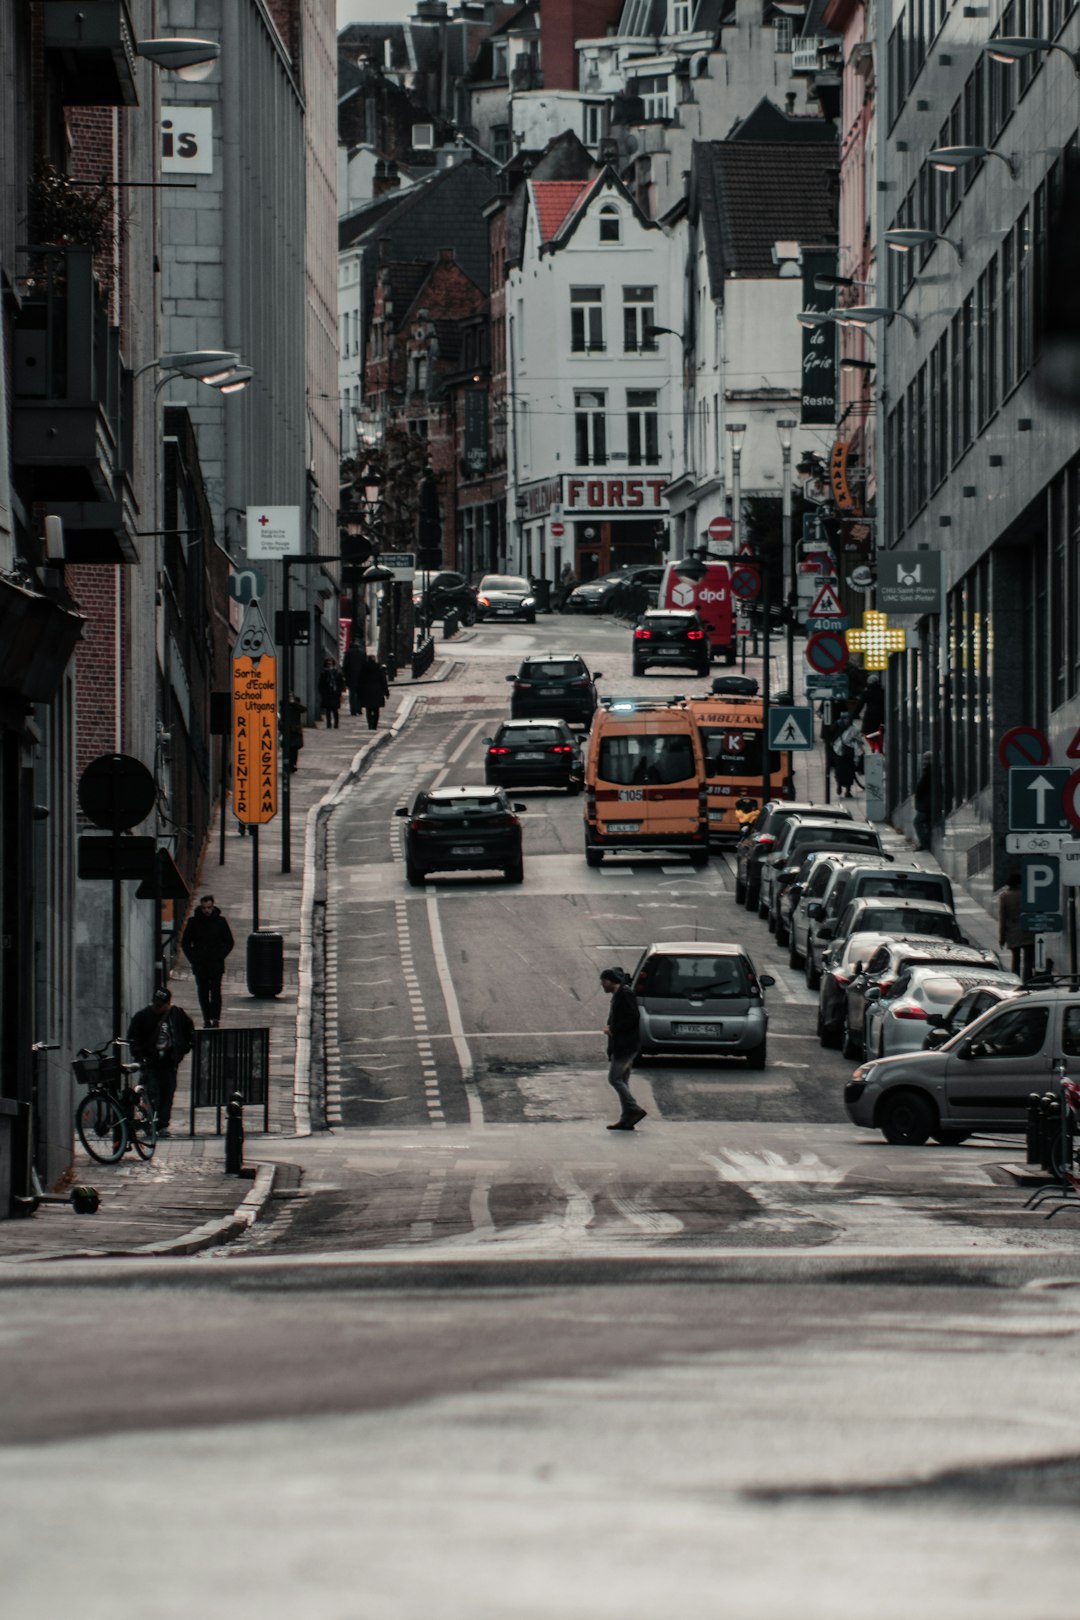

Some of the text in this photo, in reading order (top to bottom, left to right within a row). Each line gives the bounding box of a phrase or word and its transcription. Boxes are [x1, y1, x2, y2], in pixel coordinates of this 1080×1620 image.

[161, 119, 198, 158] is
[809, 328, 825, 345] de
[802, 351, 833, 374] Gris
[802, 395, 834, 406] Resto
[833, 447, 847, 502] SNACK
[567, 480, 667, 507] FORST
[698, 587, 725, 604] dpd
[814, 619, 842, 630] 40m
[234, 668, 262, 679] Sortie
[234, 690, 262, 701] School
[245, 701, 275, 714] Uitgang
[696, 713, 764, 724] AMBULAN
[728, 735, 741, 750] K
[236, 716, 248, 812] RALENTIR
[261, 716, 273, 812] LANGZAAM
[1026, 864, 1054, 904] P
